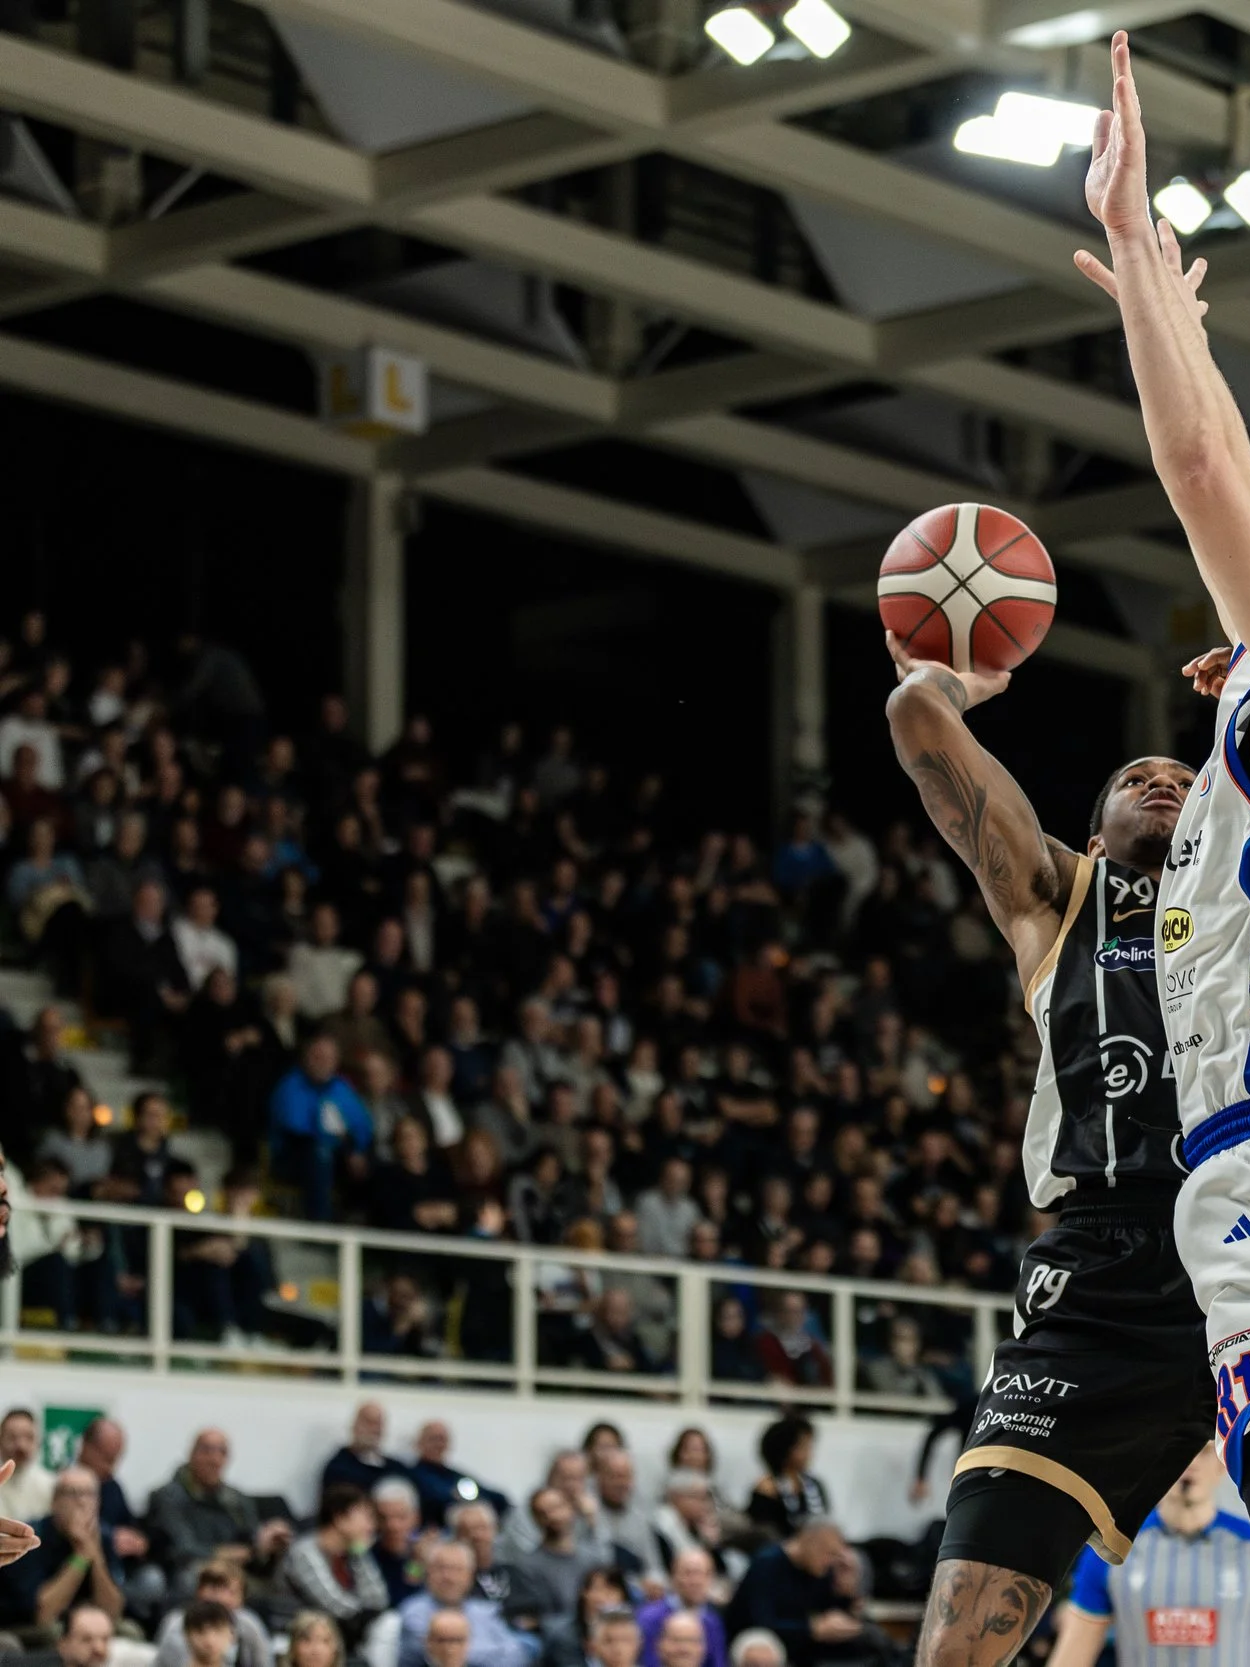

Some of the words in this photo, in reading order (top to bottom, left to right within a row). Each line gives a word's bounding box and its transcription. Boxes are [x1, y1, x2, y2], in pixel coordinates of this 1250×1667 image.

[385, 362, 415, 415] L
[992, 1373, 1080, 1398] CAVIT
[1003, 1394, 1042, 1403] TRENTO
[990, 1412, 1058, 1430] Doomiti
[1003, 1422, 1051, 1438] energia
